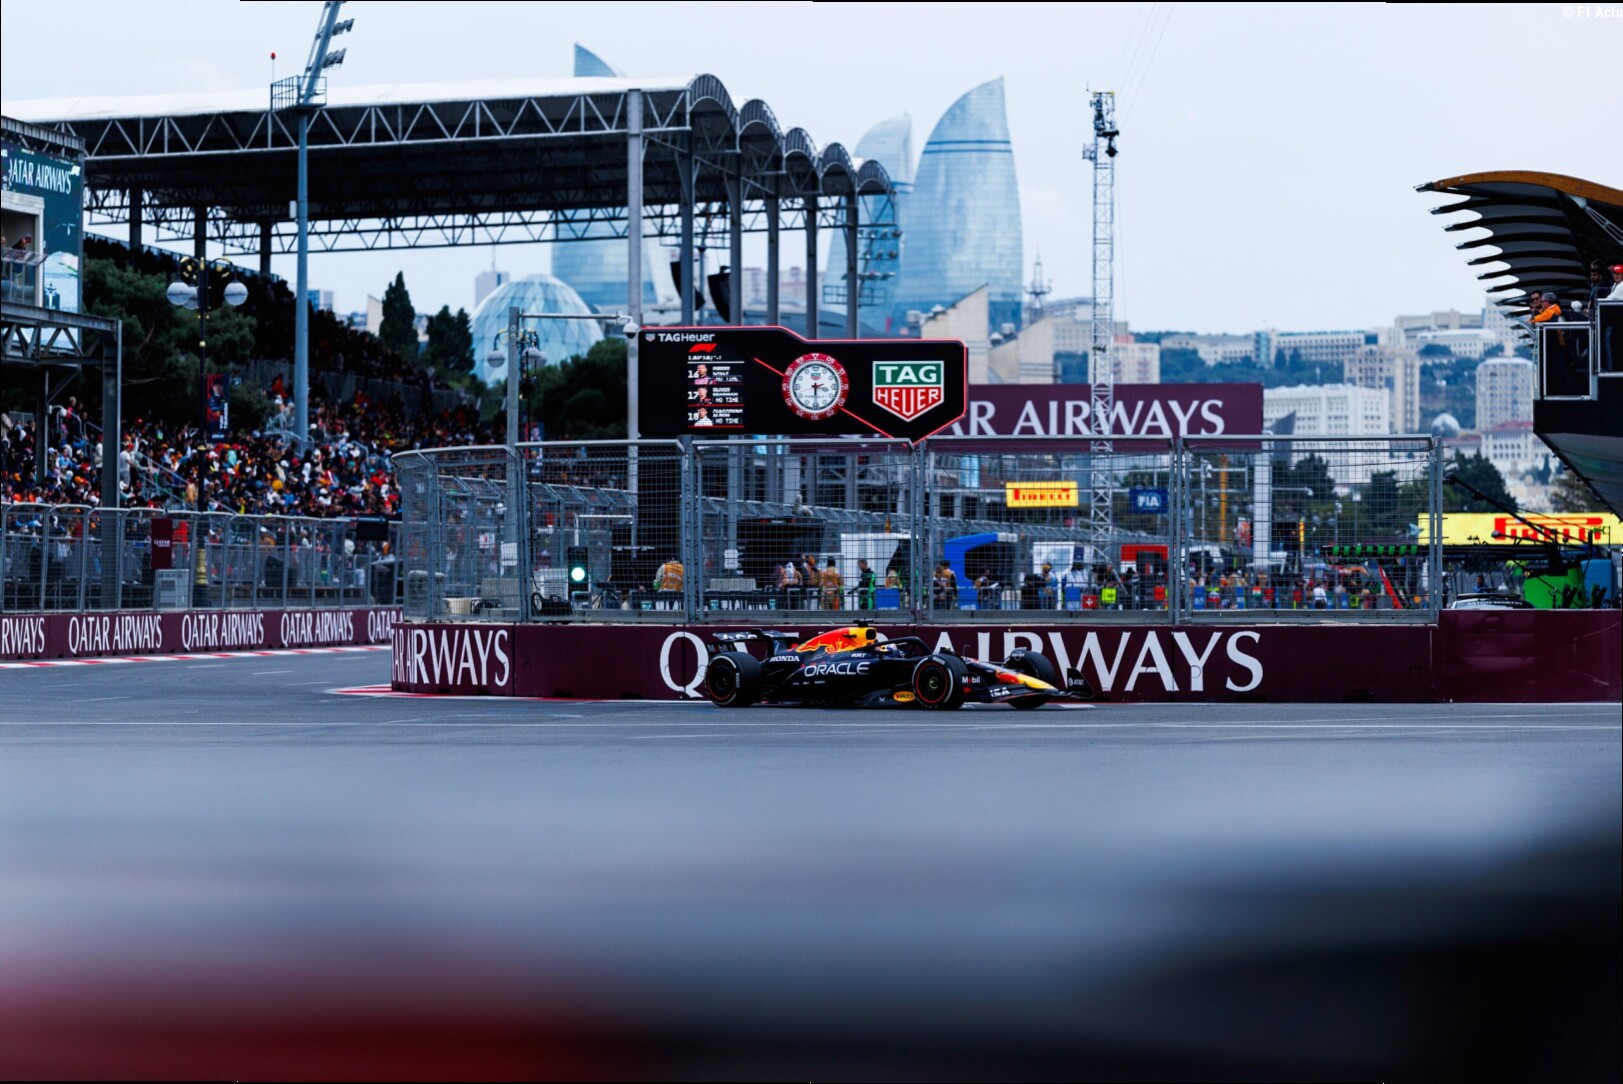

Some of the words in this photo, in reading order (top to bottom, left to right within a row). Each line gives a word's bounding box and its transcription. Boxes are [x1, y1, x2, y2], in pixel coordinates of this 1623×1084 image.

[35, 163, 72, 194] AIRWAYS
[658, 333, 680, 342] TAG
[681, 333, 715, 342] Heuer
[688, 370, 699, 378] 16
[879, 365, 937, 383] TAG
[688, 391, 699, 400] 17
[877, 388, 939, 416] HEUER
[1012, 400, 1225, 436] AIRWAYS
[1138, 495, 1159, 507] FIA
[1, 617, 45, 654] RWAYS
[68, 616, 110, 654] QATAR
[112, 615, 162, 649] AIRWAYS
[182, 614, 218, 649] QATAR
[220, 613, 264, 646] AIRWAYS
[281, 613, 313, 647] QATAR
[314, 611, 354, 642] AIRWAYS
[406, 628, 510, 686] AIRWAYS
[804, 661, 871, 677] ORACLE
